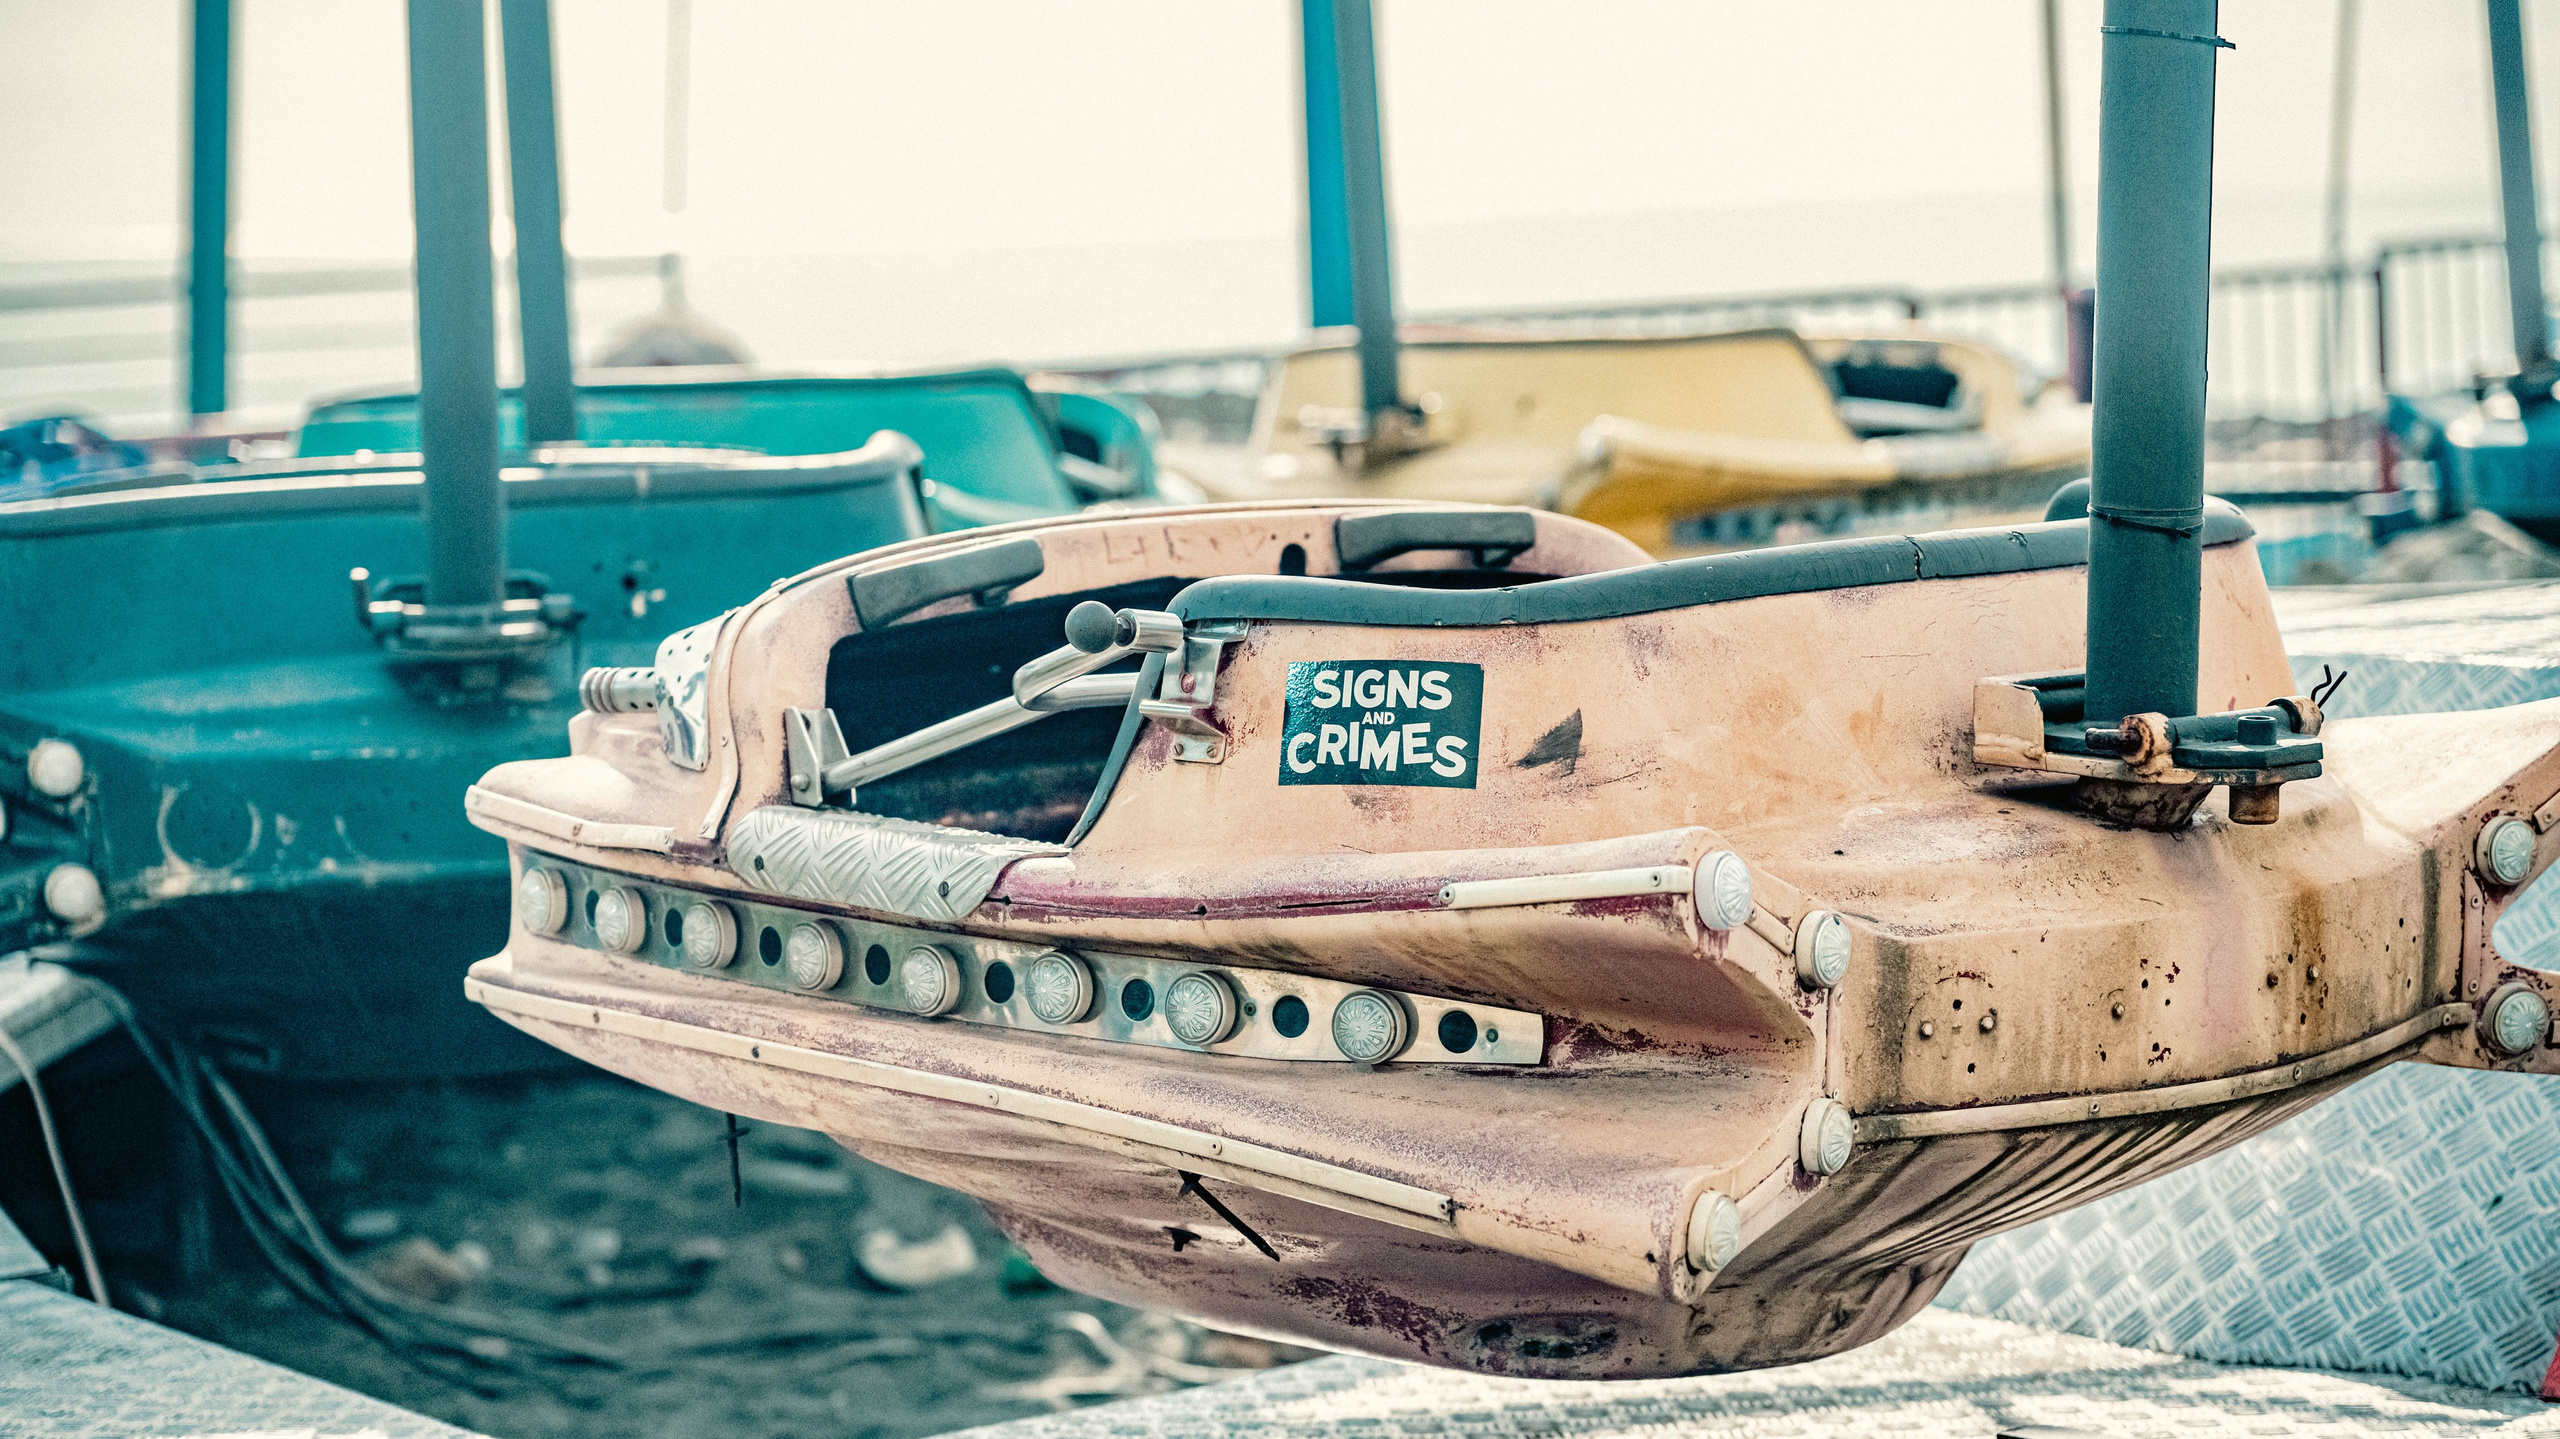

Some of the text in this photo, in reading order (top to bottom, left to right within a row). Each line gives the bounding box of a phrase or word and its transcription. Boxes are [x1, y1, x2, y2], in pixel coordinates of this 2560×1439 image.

[1311, 669, 1452, 710] SIGNS
[1361, 711, 1395, 725] AND
[1287, 721, 1468, 778] CRIMES
